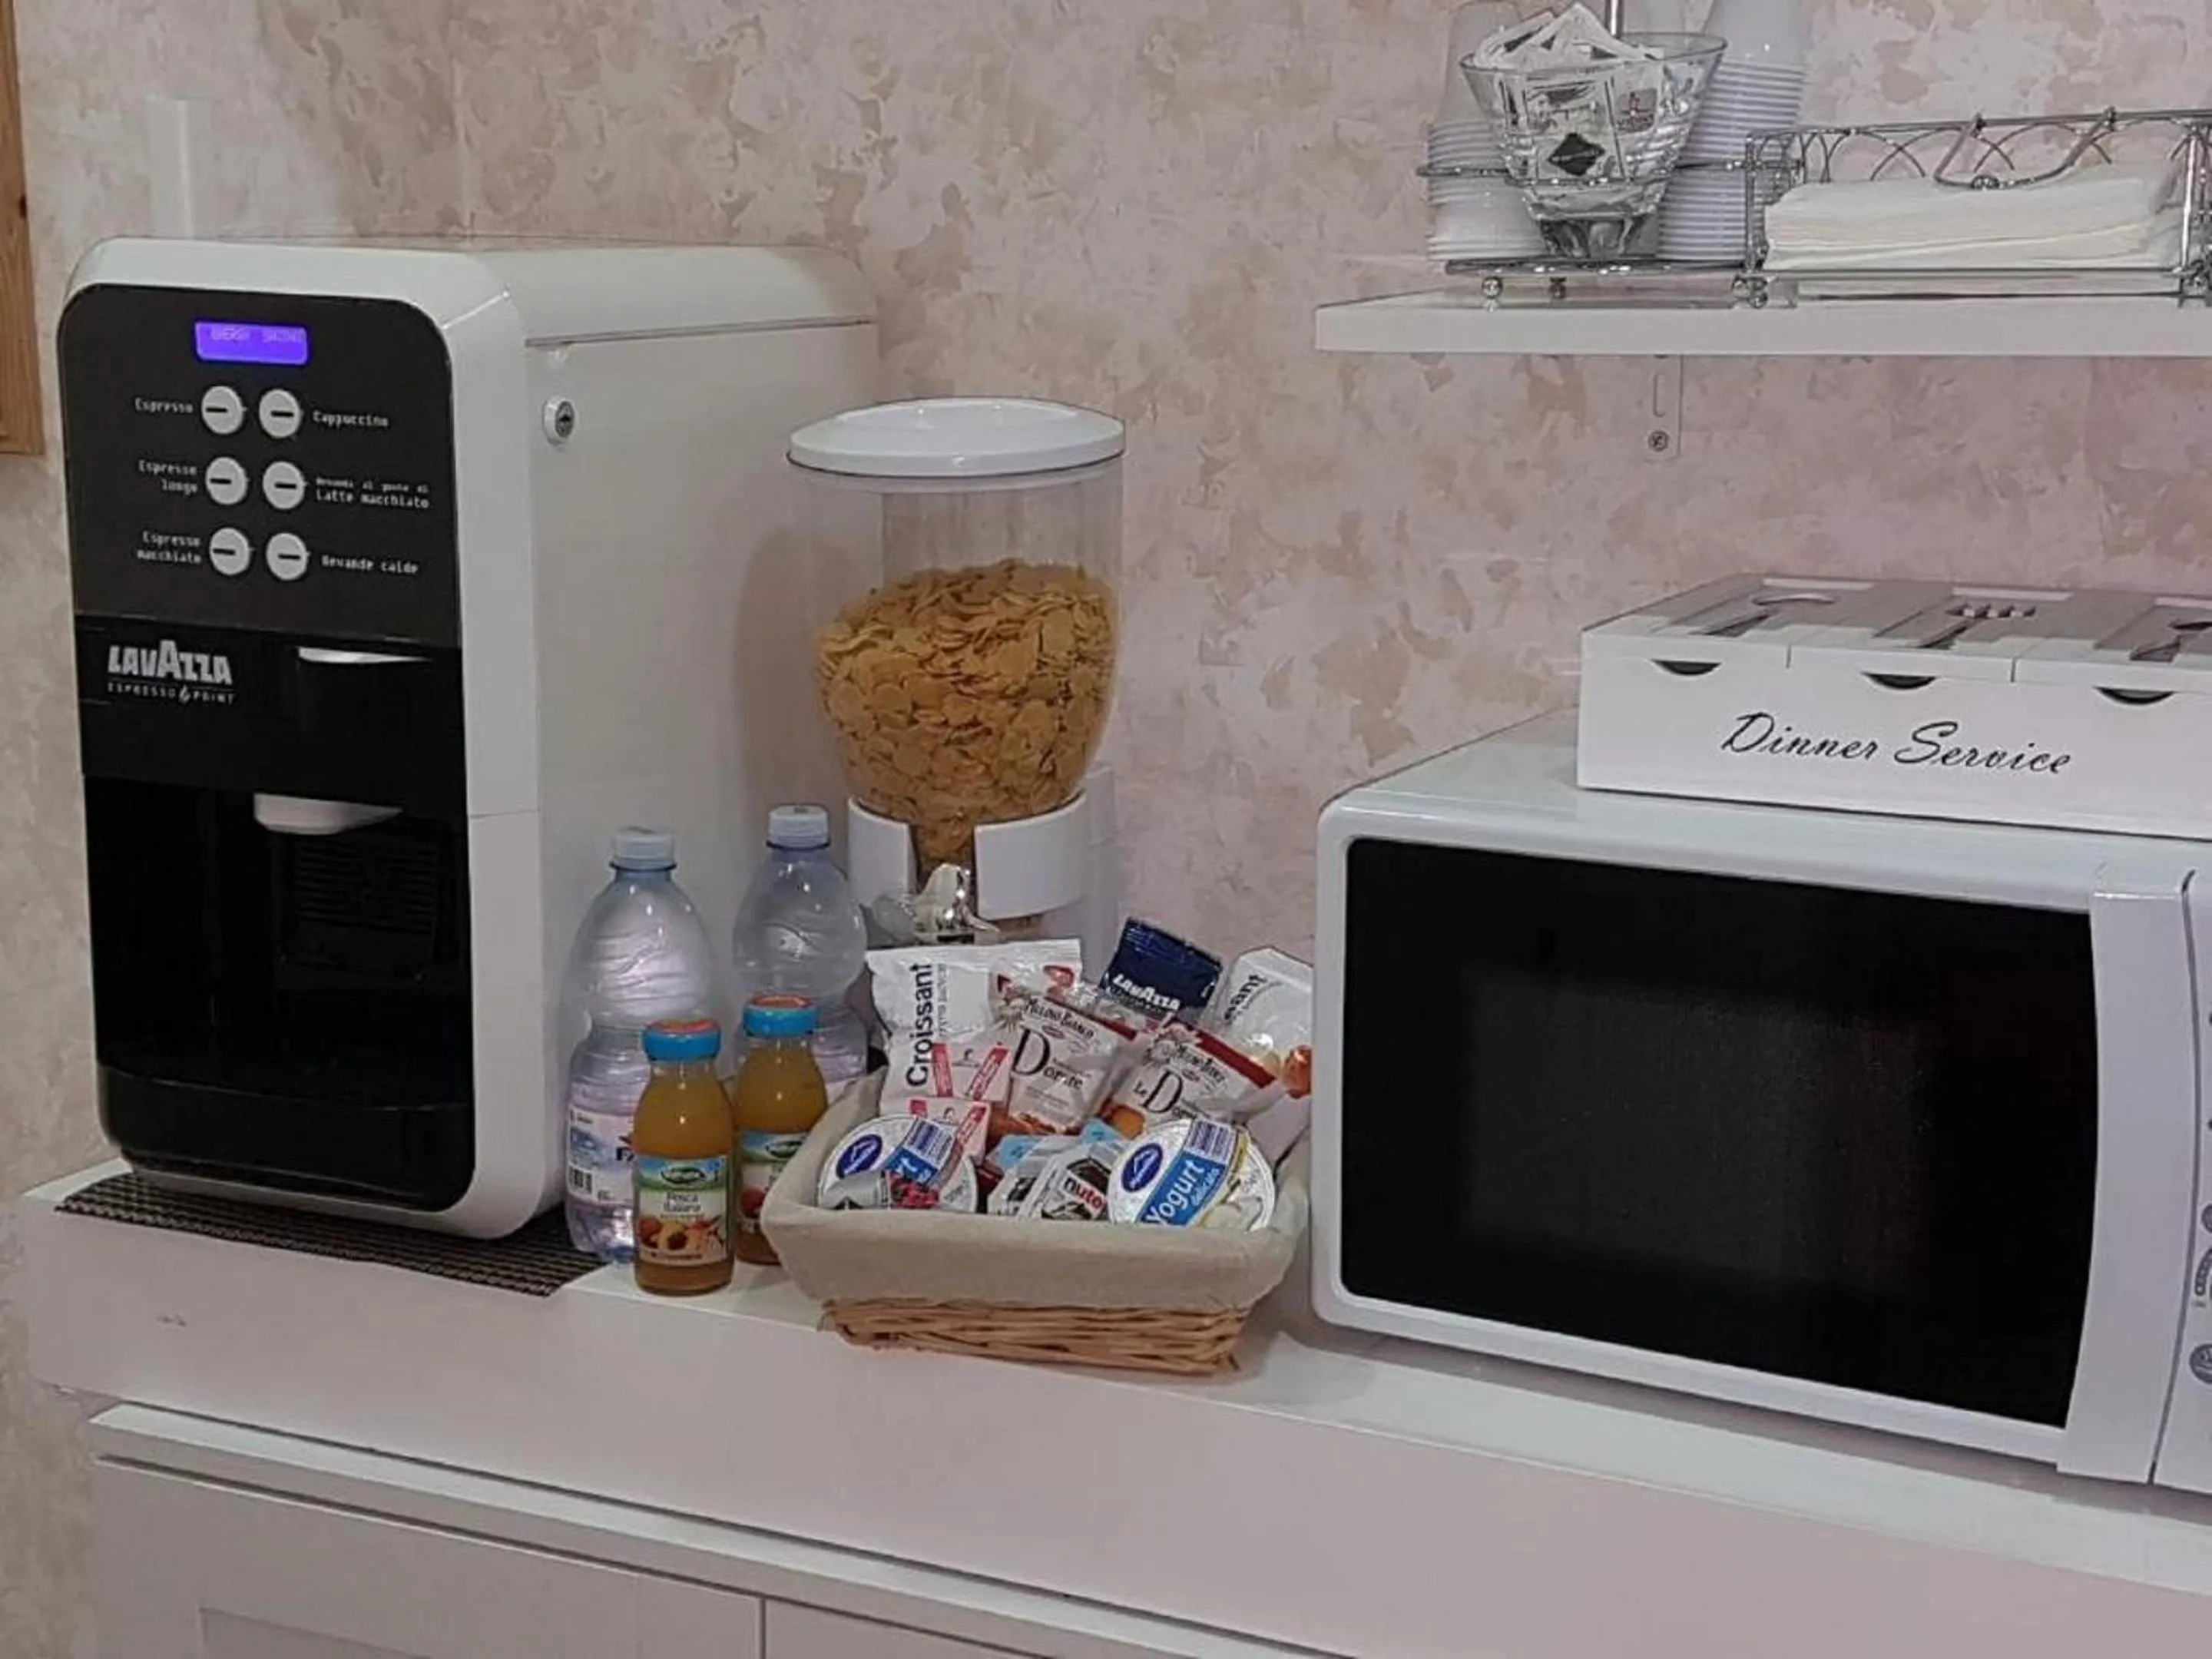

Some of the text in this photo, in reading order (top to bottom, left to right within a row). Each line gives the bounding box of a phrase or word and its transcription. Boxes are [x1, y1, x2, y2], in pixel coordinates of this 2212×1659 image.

[134, 397, 194, 413] Espresso
[313, 409, 389, 428] Cappuccino
[137, 459, 197, 476] Espresso
[142, 531, 201, 547] Espresso
[108, 639, 232, 685] LAVAZZA
[1720, 712, 2073, 774] Dinner Service
[906, 962, 934, 1087] Croissant
[1145, 1159, 1206, 1226] Yogurt
